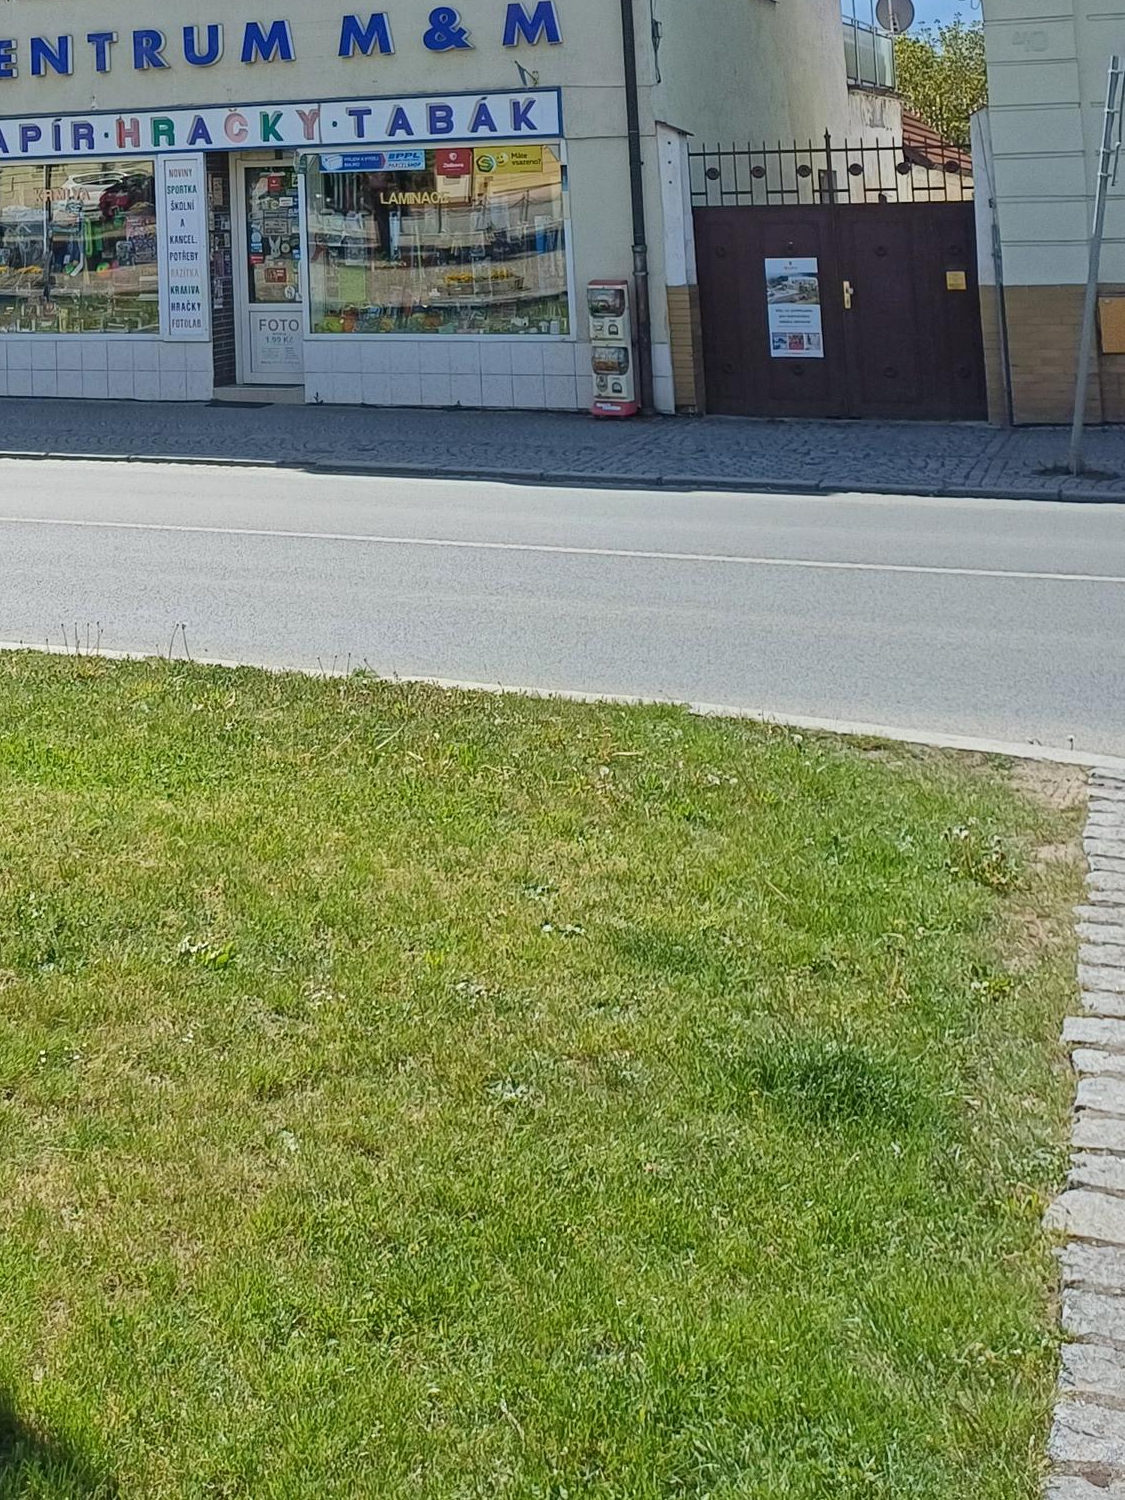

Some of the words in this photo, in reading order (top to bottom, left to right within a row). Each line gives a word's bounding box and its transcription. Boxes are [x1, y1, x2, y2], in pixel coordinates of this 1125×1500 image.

[338, 12, 395, 58] M
[422, 6, 475, 53] &
[502, 0, 563, 48] M
[168, 168, 192, 178] NOVINY
[167, 185, 197, 195] SPORTKA
[170, 201, 195, 211] ŠKOLNÍ
[180, 218, 185, 227] A
[169, 235, 198, 244] KANCEL.
[169, 251, 198, 261] POTŘEBY
[170, 285, 200, 295] KRMIVA
[171, 300, 201, 312] HRAČKY
[259, 319, 299, 331] FOTO
